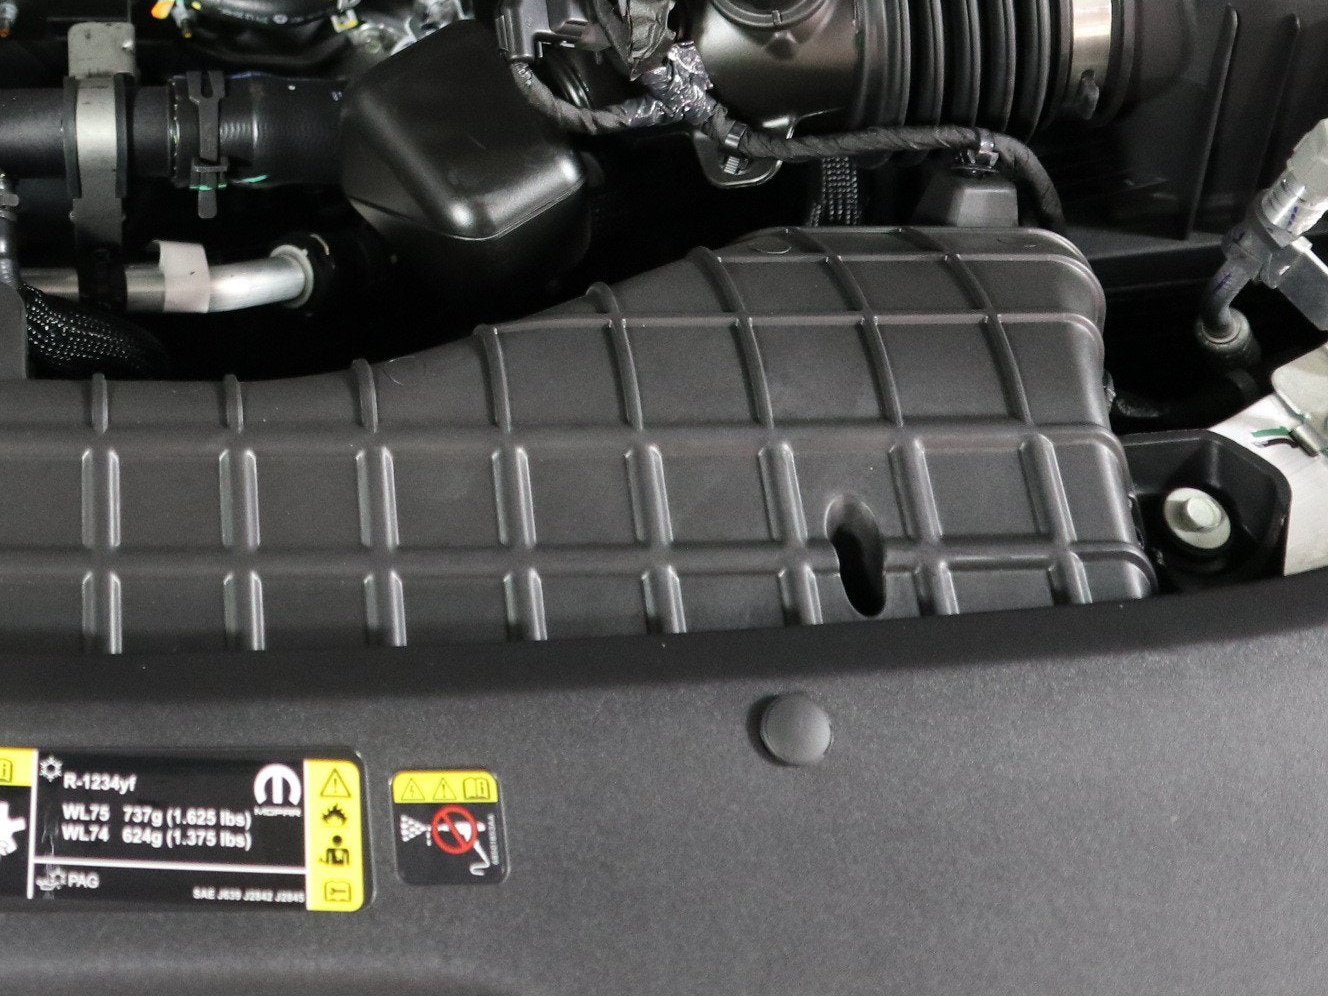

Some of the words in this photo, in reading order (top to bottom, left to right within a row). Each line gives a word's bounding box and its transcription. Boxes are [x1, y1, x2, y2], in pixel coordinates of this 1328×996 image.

[63, 770, 138, 795] R-1234yf
[61, 802, 111, 822] WL75
[122, 804, 164, 828] 737g
[166, 806, 218, 829] (1.625
[219, 807, 253, 832] lbs)
[253, 806, 302, 817] MOPAR
[60, 822, 111, 843] WL74
[121, 824, 164, 849] 624g
[166, 827, 218, 850] (1.375
[219, 829, 253, 853] lbs)
[67, 871, 100, 890] PAG
[192, 887, 216, 900] SAE
[217, 888, 242, 901] J639
